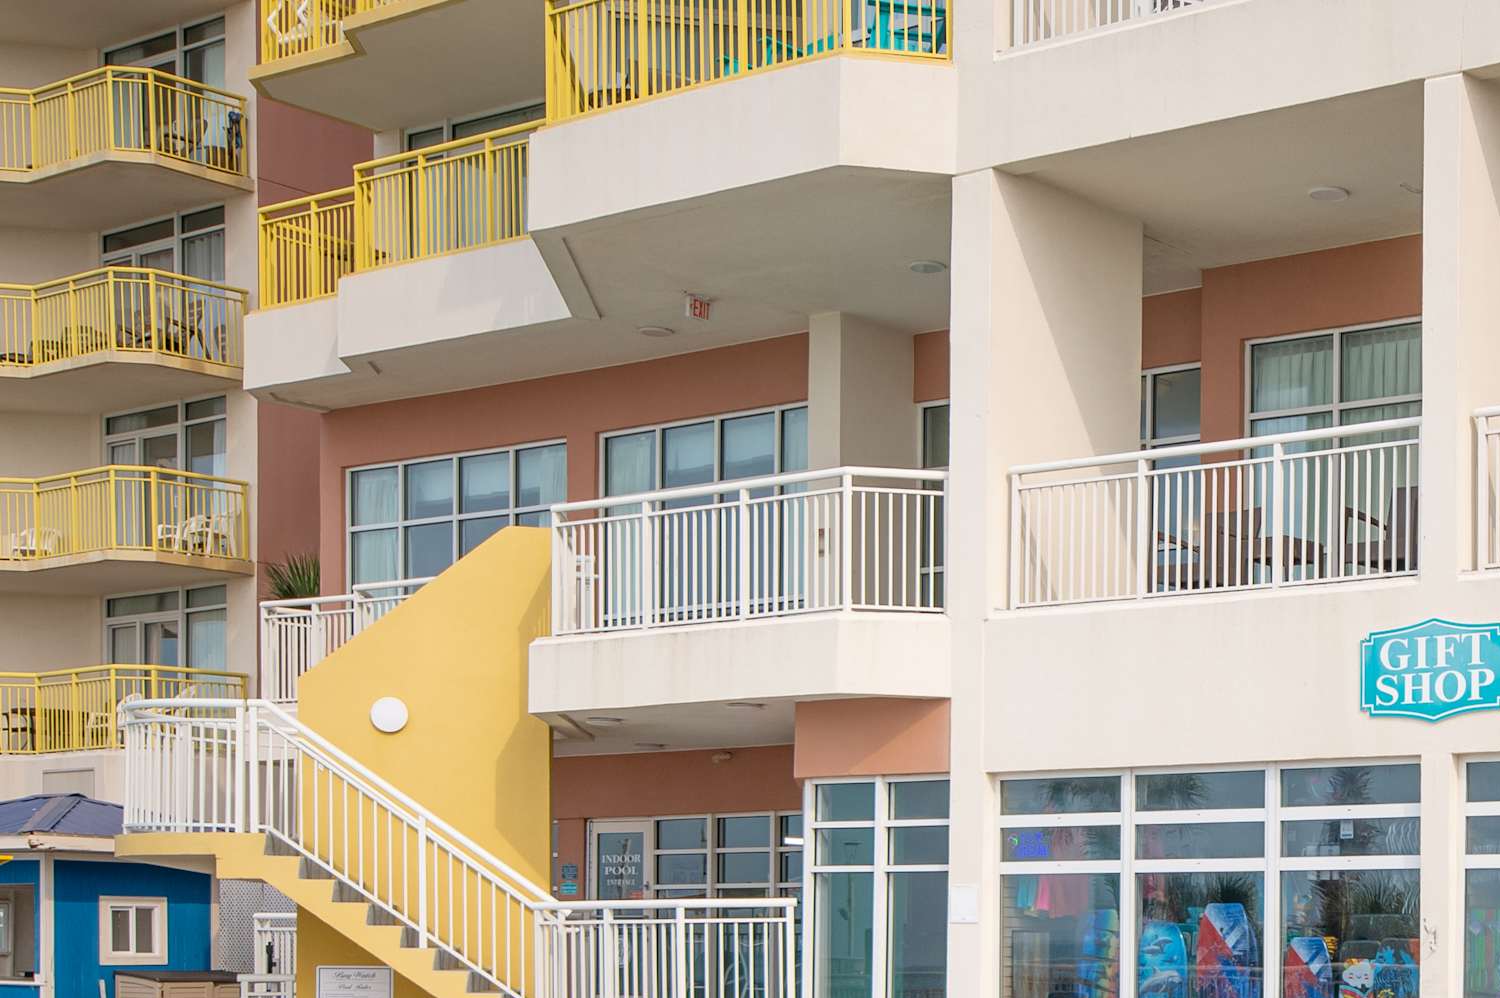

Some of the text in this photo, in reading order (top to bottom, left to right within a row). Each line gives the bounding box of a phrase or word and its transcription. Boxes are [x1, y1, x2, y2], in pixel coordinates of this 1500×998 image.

[693, 299, 710, 320] EXIT
[1379, 632, 1491, 671] GIFT
[1375, 668, 1496, 706] SHOP
[601, 854, 641, 863] INDOOR
[604, 865, 639, 875] POOL
